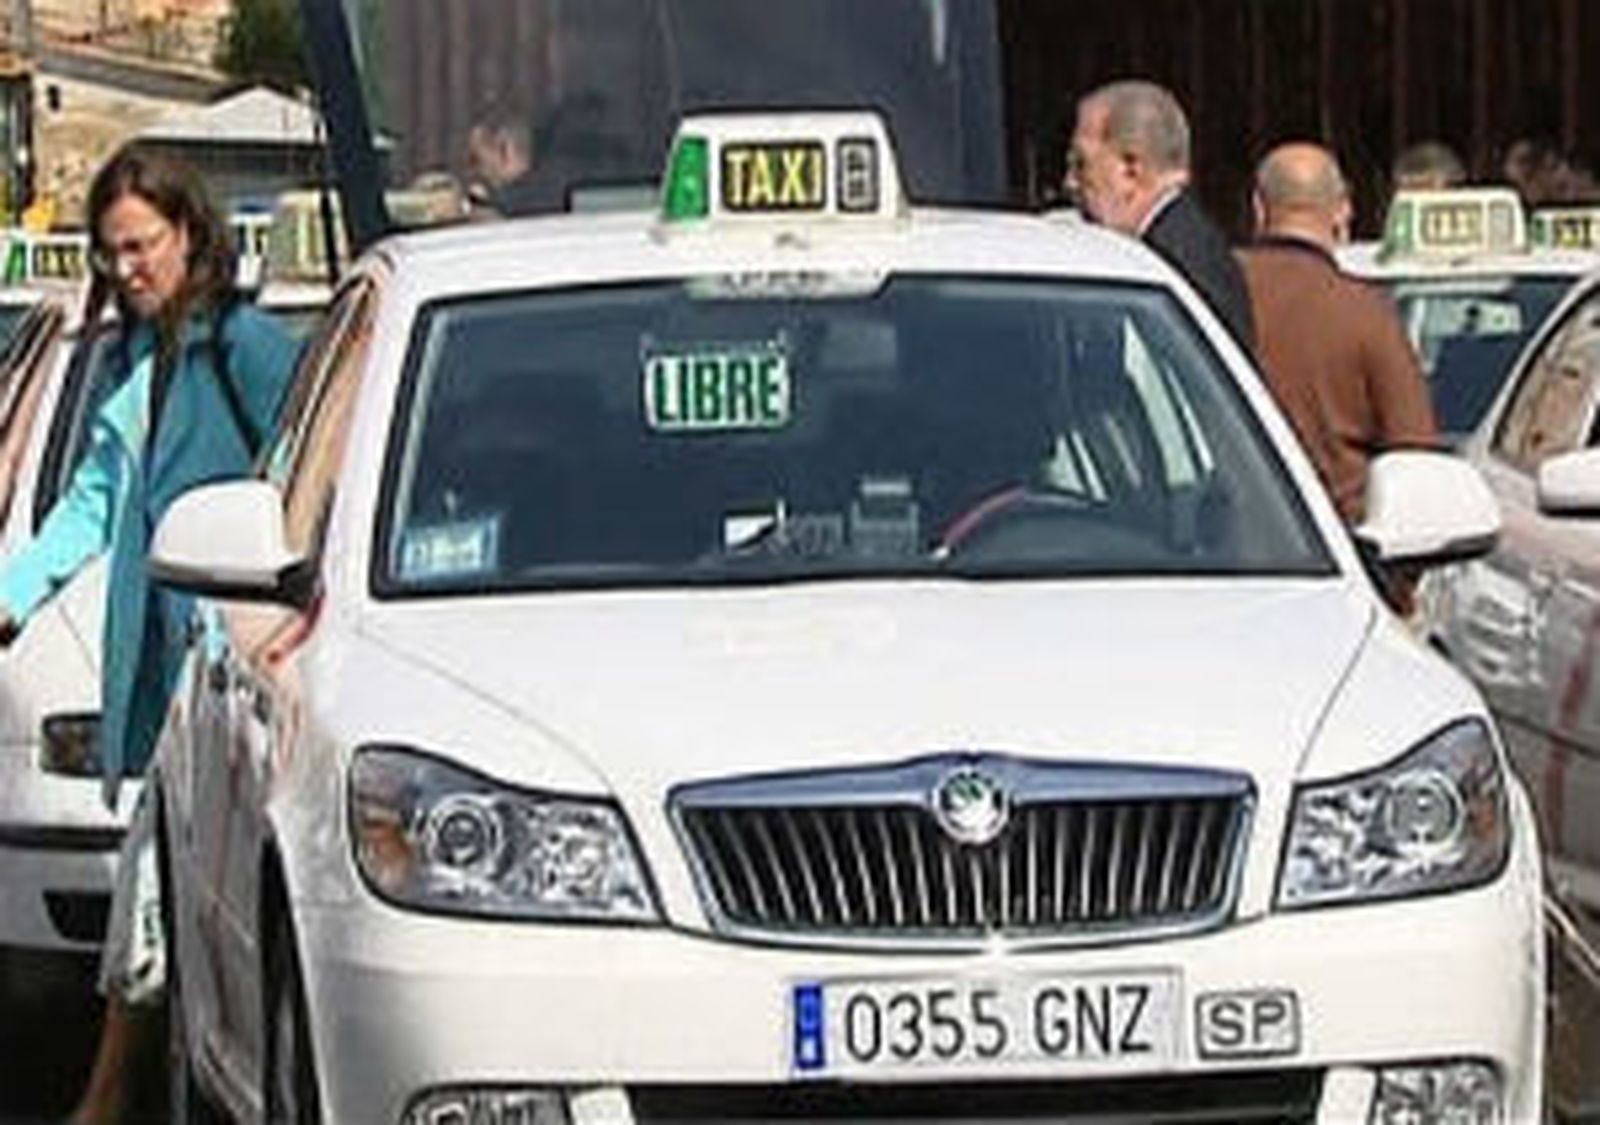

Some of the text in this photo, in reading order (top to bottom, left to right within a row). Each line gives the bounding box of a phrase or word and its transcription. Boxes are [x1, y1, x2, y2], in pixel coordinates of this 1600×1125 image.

[725, 149, 824, 206] TAXI
[655, 357, 779, 422] LIBRE
[845, 984, 1152, 1063] 0355 GNZ
[1208, 1000, 1287, 1047] SP
